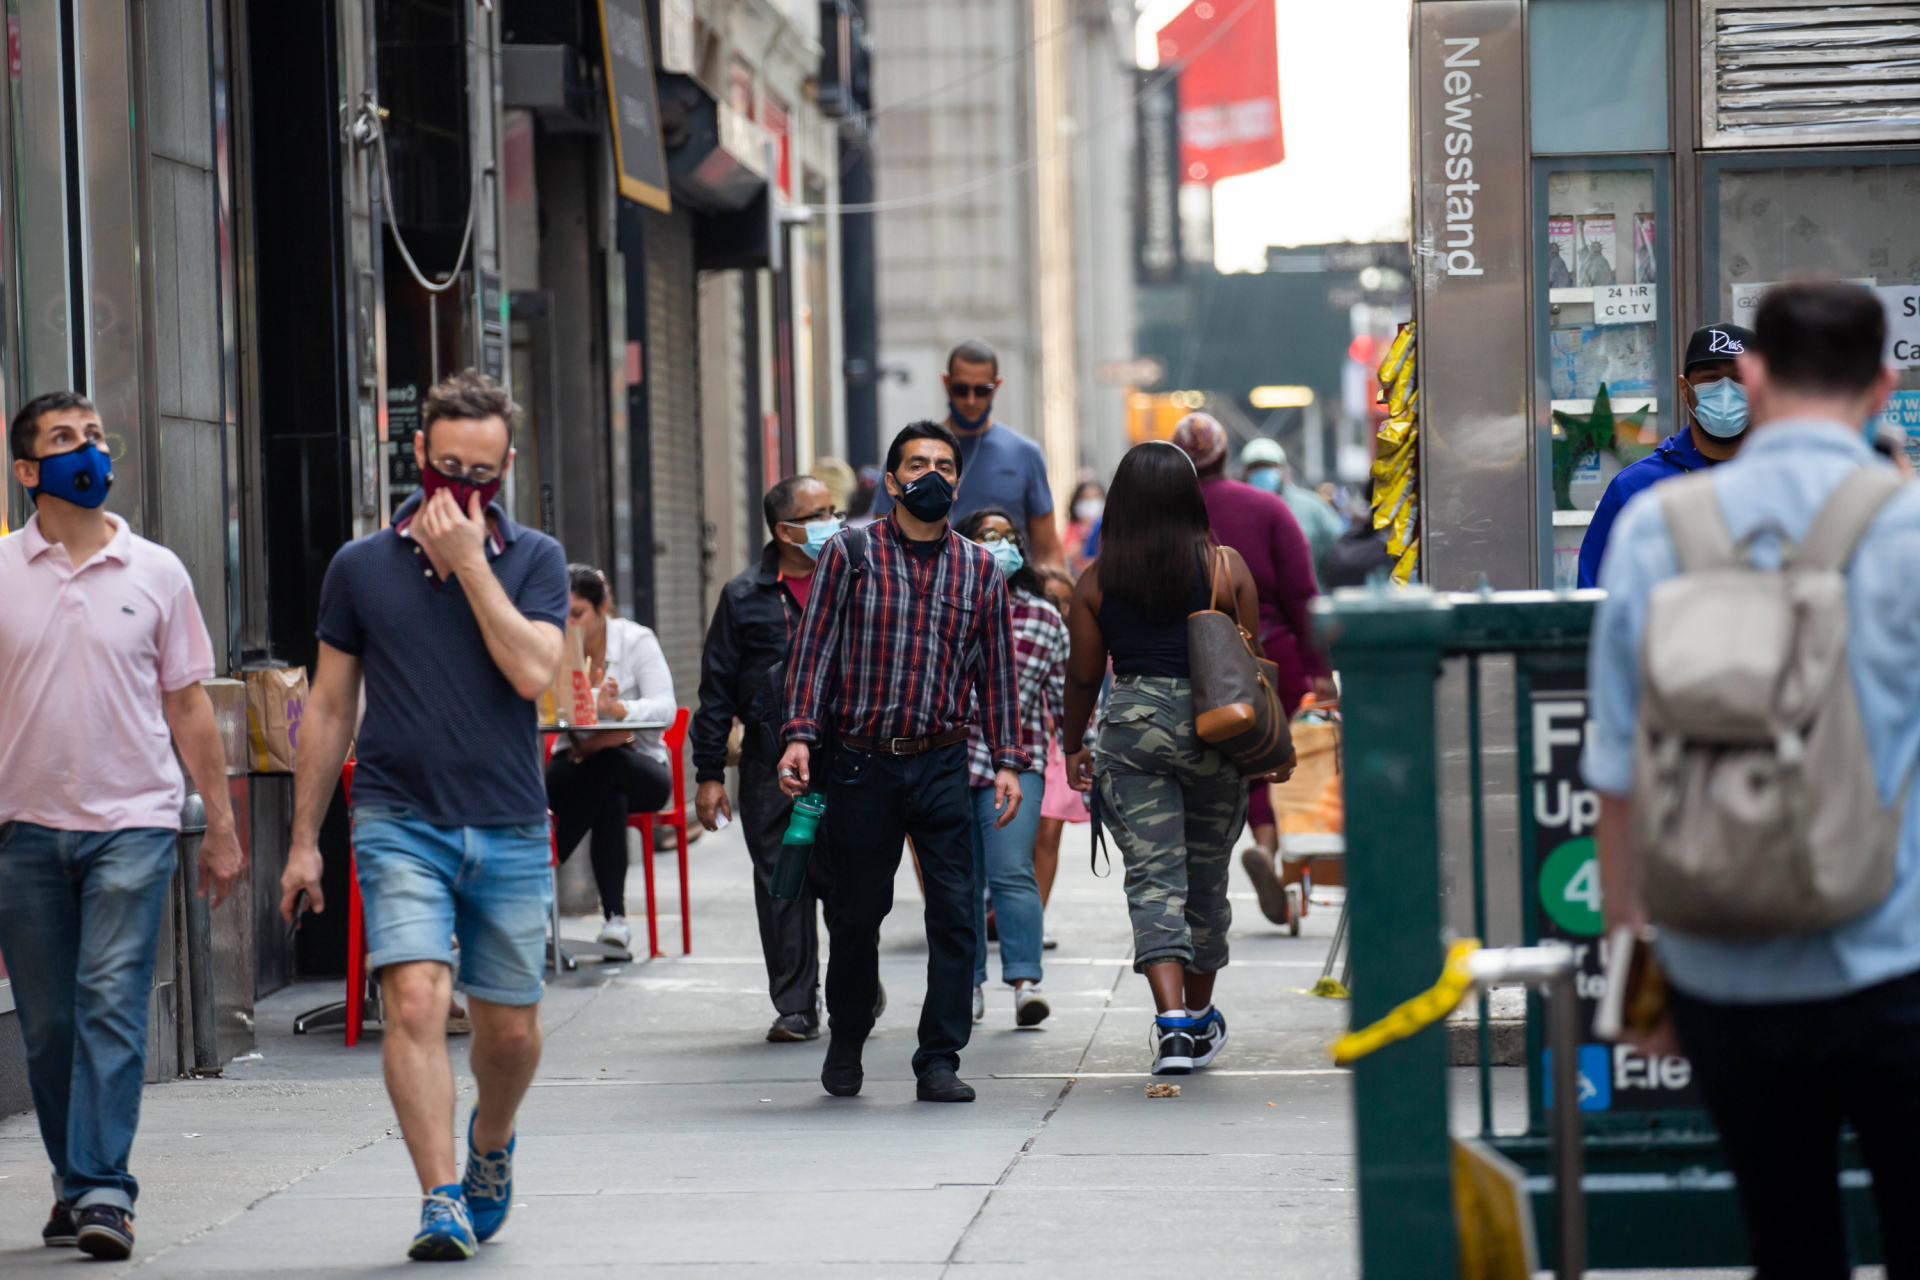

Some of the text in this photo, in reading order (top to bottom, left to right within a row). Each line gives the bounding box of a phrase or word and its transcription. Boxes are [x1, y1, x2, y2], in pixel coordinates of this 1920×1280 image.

[1443, 37, 1484, 276] Newsstand
[1549, 221, 1572, 233] YC
[1608, 286, 1648, 298] 24 HR
[1903, 296, 1920, 317] S
[1563, 857, 1603, 913] 4
